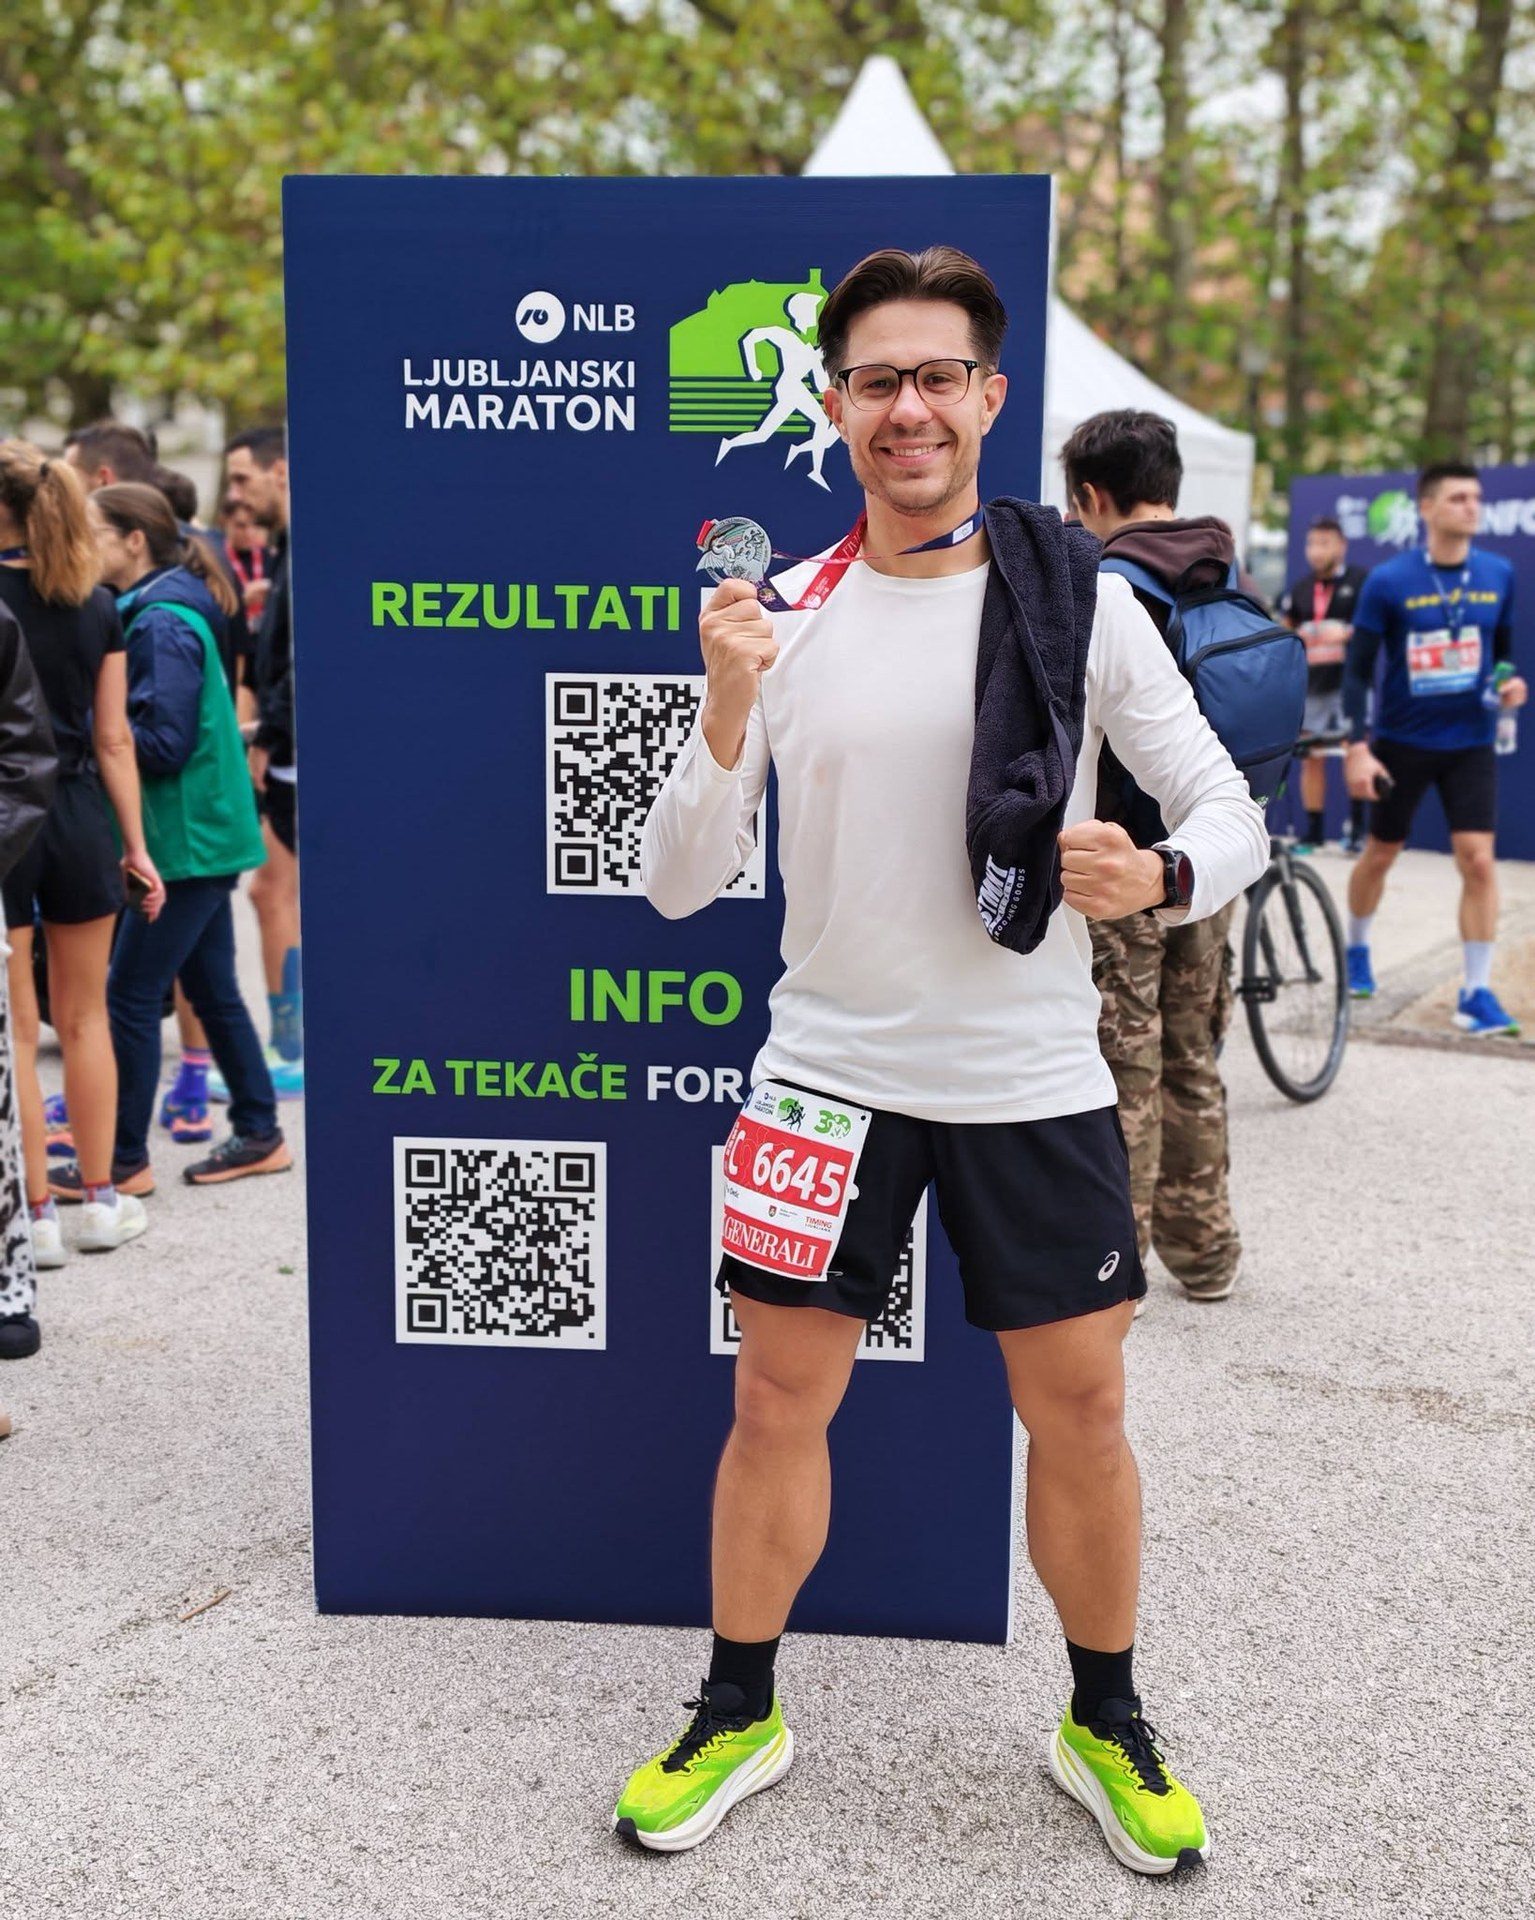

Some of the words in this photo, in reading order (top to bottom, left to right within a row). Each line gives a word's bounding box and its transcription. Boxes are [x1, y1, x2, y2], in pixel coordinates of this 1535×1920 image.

[573, 304, 635, 332] NLB
[403, 358, 635, 388] LJUBLJANSKI
[404, 393, 635, 431] MARATON
[371, 582, 680, 630] REZULTATI
[1013, 869, 1026, 902] GOODS
[570, 969, 743, 1025] INFO
[372, 1058, 436, 1094] ZA
[446, 1053, 626, 1099] TEKAČE
[647, 1065, 745, 1104] FOR
[728, 1129, 747, 1176] C
[752, 1142, 846, 1207] 6645
[724, 1216, 820, 1269] GENERALI
[805, 1216, 833, 1229] TIMING
